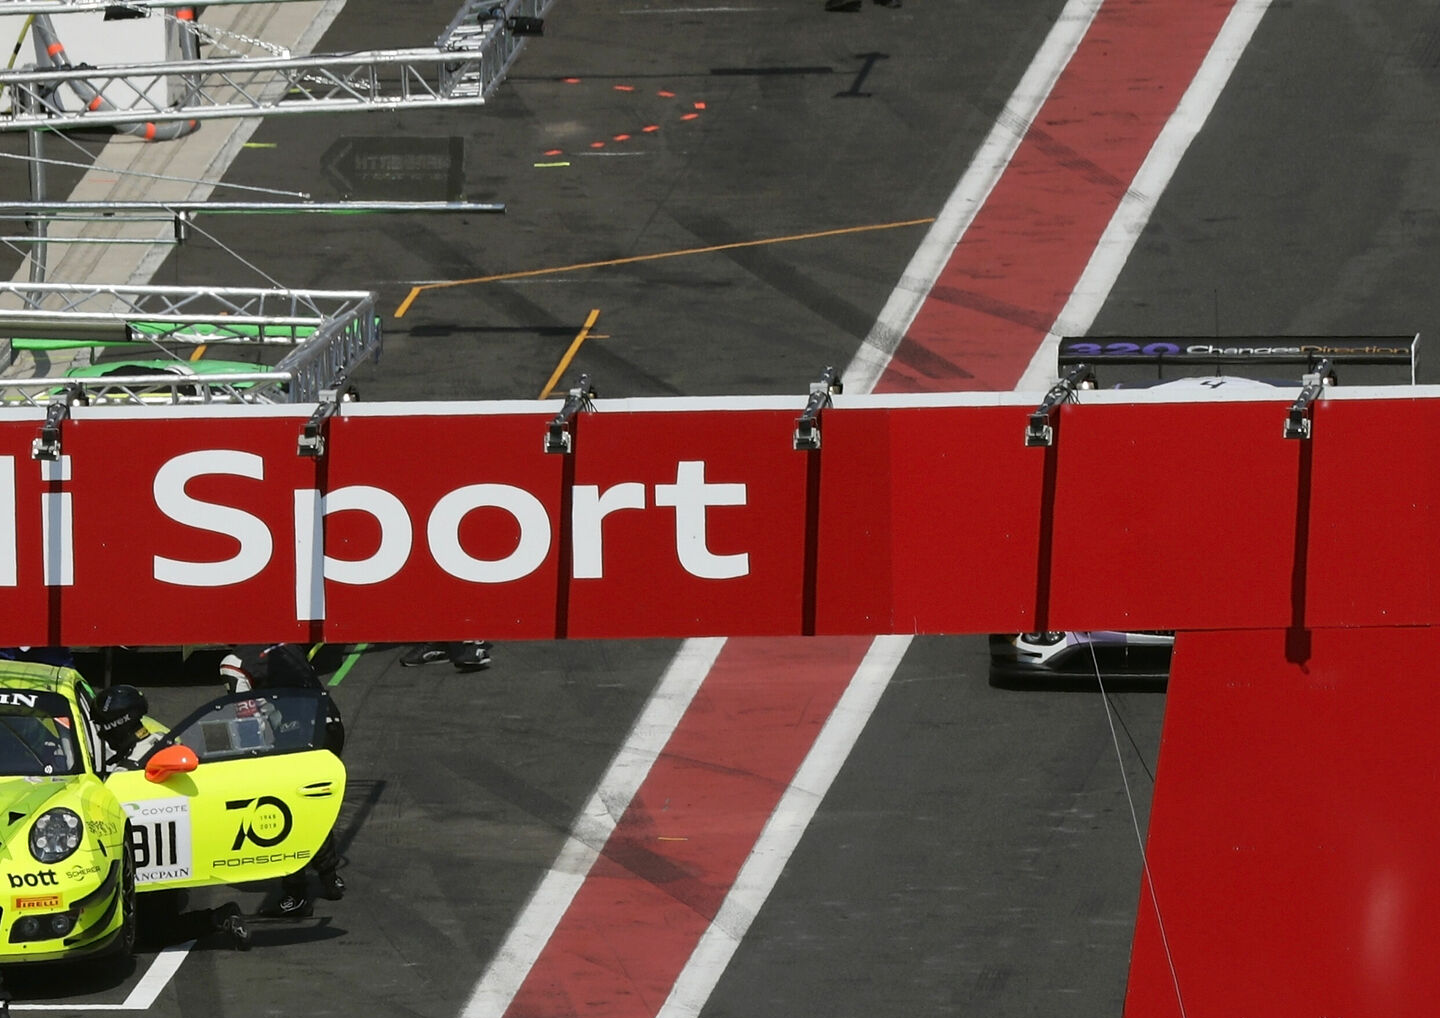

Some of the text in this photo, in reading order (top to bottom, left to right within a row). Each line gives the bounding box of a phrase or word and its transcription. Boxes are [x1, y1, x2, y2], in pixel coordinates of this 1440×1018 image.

[1067, 342, 1181, 355] 320
[1199, 379, 1227, 390] 4
[152, 449, 751, 623] Sport
[103, 713, 131, 731] uvex
[141, 804, 188, 816] COYOTE
[225, 795, 293, 851] 70
[212, 849, 312, 869] PORSCHE
[7, 869, 60, 889] bott
[15, 895, 60, 909] PIRELLI
